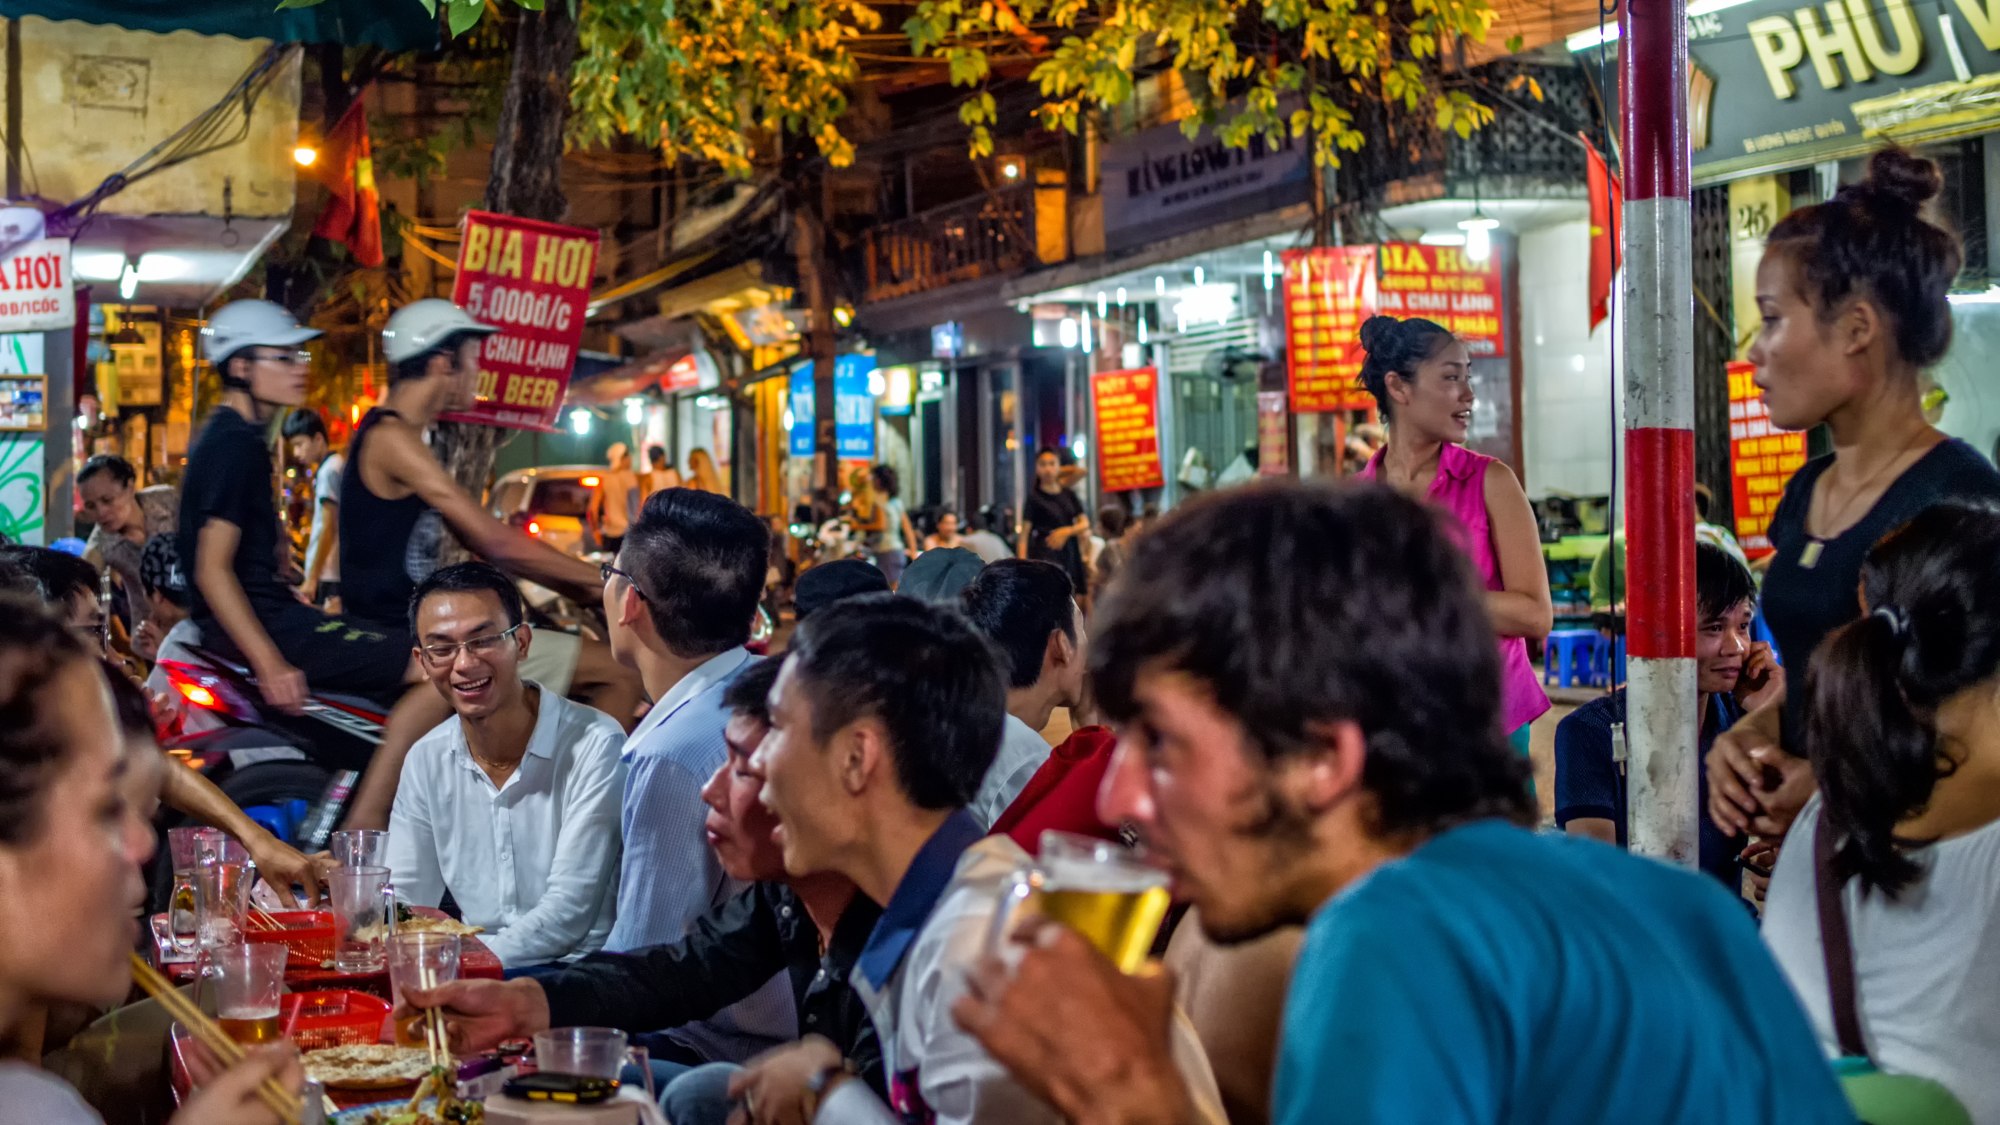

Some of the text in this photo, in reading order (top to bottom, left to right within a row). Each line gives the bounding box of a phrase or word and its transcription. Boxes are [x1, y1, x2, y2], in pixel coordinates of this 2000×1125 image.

[464, 223, 594, 290] BIA HƠI
[1407, 292, 1448, 311] CHAI
[484, 334, 526, 364] CHAI
[525, 339, 570, 375] LẠNH
[503, 373, 560, 409] BEER
[1728, 372, 1764, 401] BI
